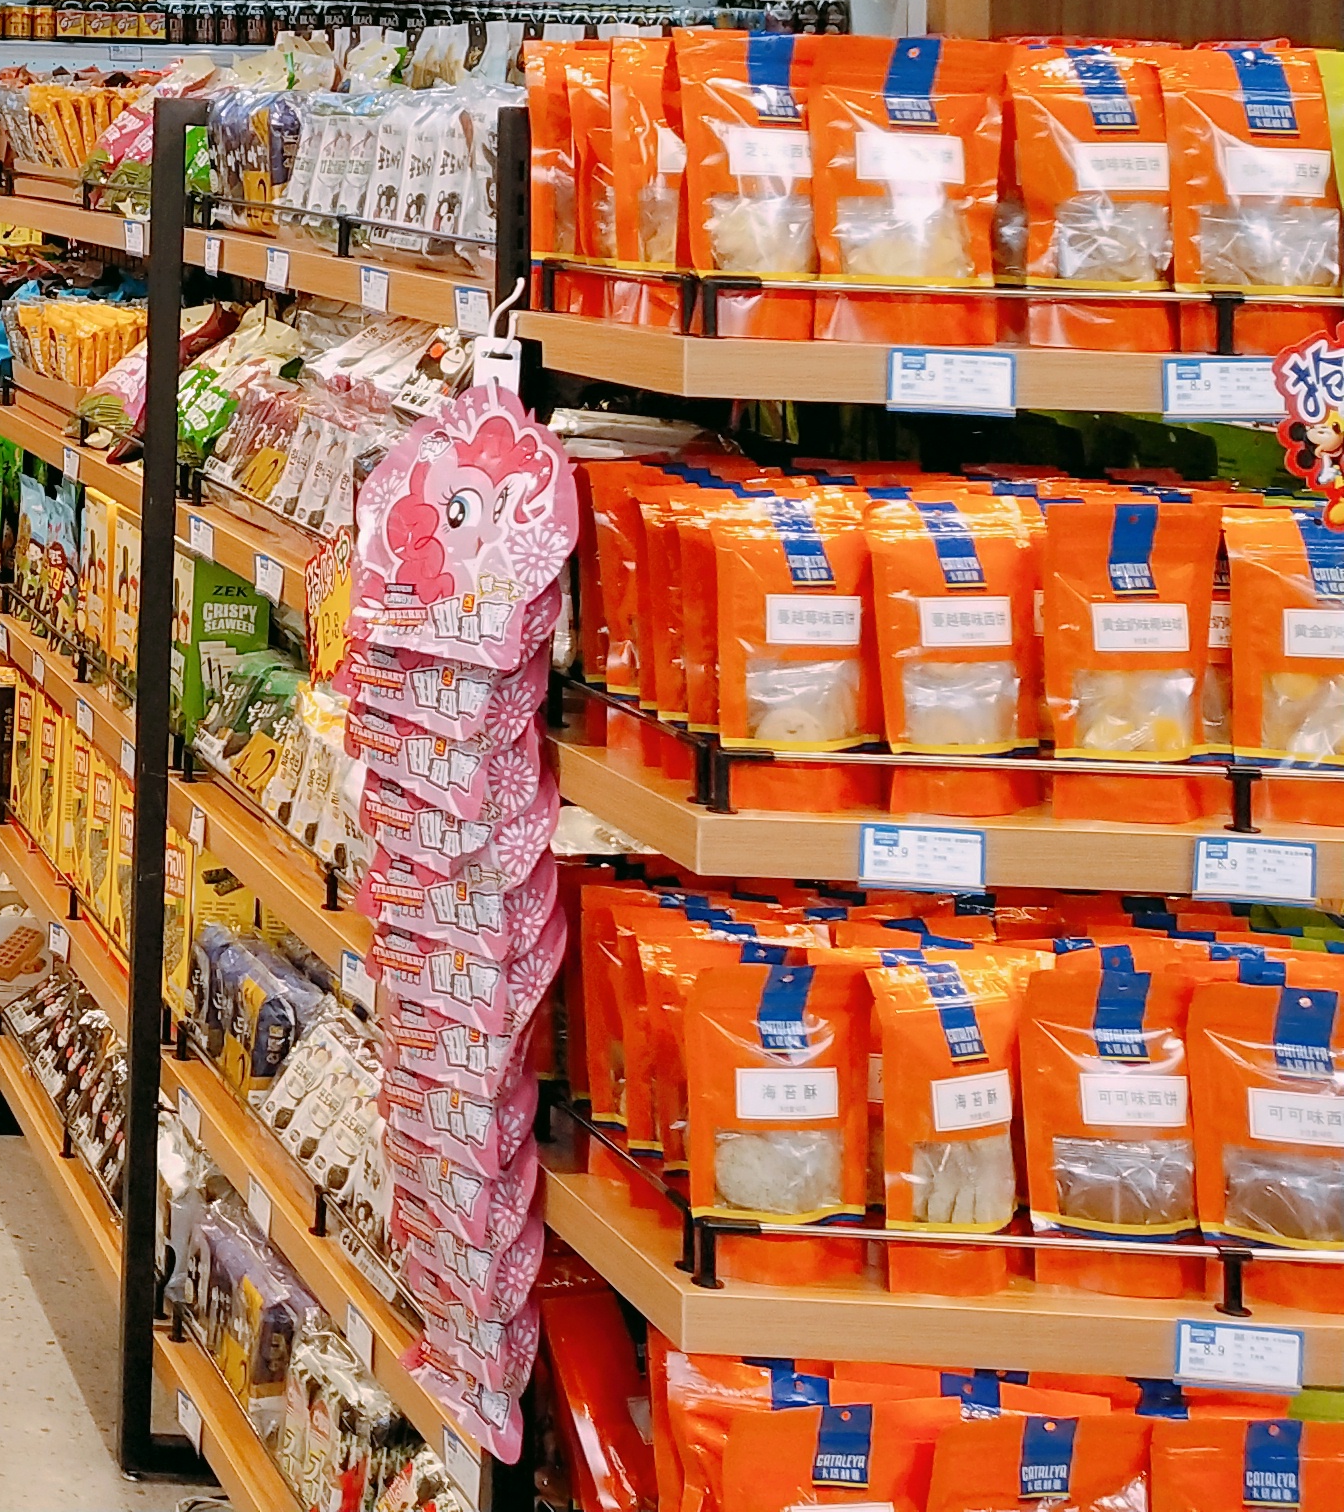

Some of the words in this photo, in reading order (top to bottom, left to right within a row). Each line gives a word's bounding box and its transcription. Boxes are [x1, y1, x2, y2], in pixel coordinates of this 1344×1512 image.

[211, 584, 250, 599] ZEK
[202, 603, 259, 622] CRISPY
[203, 618, 256, 637] SEAWEED
[761, 1082, 819, 1102] 海苔酥
[953, 1087, 999, 1111] 海苔酥
[1097, 1088, 1180, 1108] 可可味西饼
[1202, 1342, 1227, 1358] 8.9
[815, 1452, 868, 1471] CATALEYA
[1244, 1468, 1299, 1490] CATALEYA
